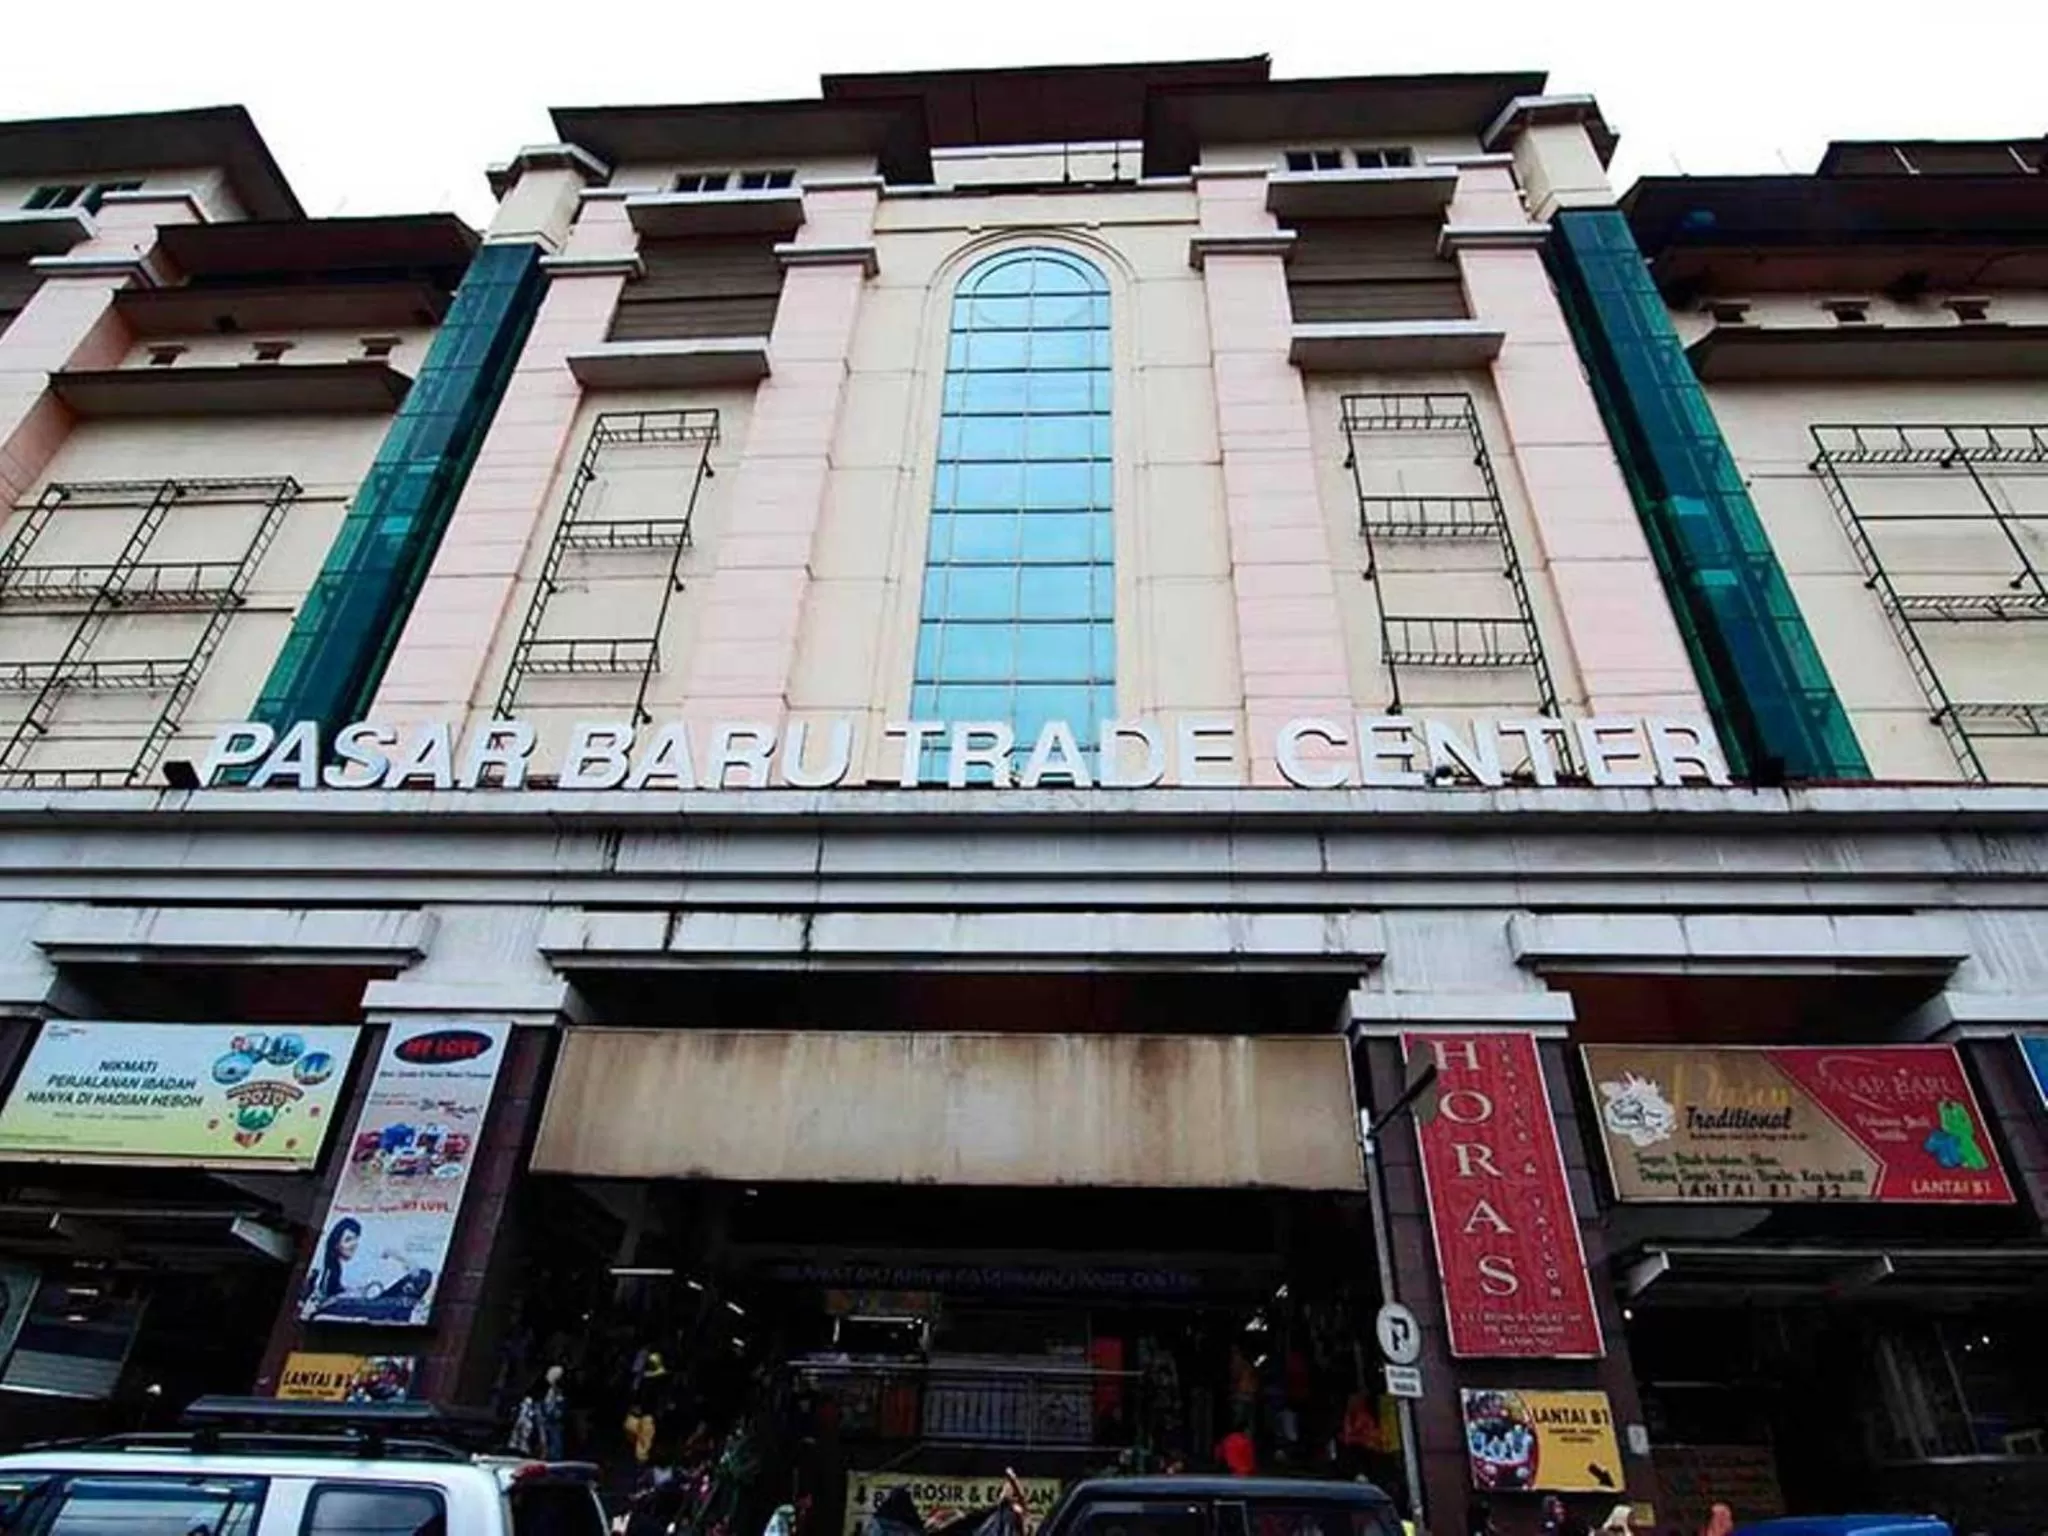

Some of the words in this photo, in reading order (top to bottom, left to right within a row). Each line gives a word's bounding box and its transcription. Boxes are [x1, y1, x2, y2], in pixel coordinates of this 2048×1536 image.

[199, 720, 536, 789] PASAR
[556, 720, 854, 789] BARU
[886, 718, 1235, 788] TRADE
[1274, 716, 1732, 787] CENTER
[98, 1060, 159, 1073] NIKMATI
[47, 1074, 141, 1090] PERJALANAN
[140, 1077, 197, 1091] IBADAH
[76, 1092, 93, 1106] DI
[1686, 1106, 1792, 1130] Traditional
[1430, 1039, 1520, 1297] HORAS
[1677, 1183, 1755, 1197] LANTAI
[1769, 1183, 1792, 1197] B1
[1816, 1183, 1842, 1199] B2
[1911, 1178, 1969, 1195] LANTAI
[1391, 1317, 1410, 1352] P
[283, 1371, 332, 1388] LANTAI
[1532, 1407, 1588, 1425] LANTAI
[1590, 1408, 1610, 1425] B1
[911, 1483, 964, 1501] ROSIR
